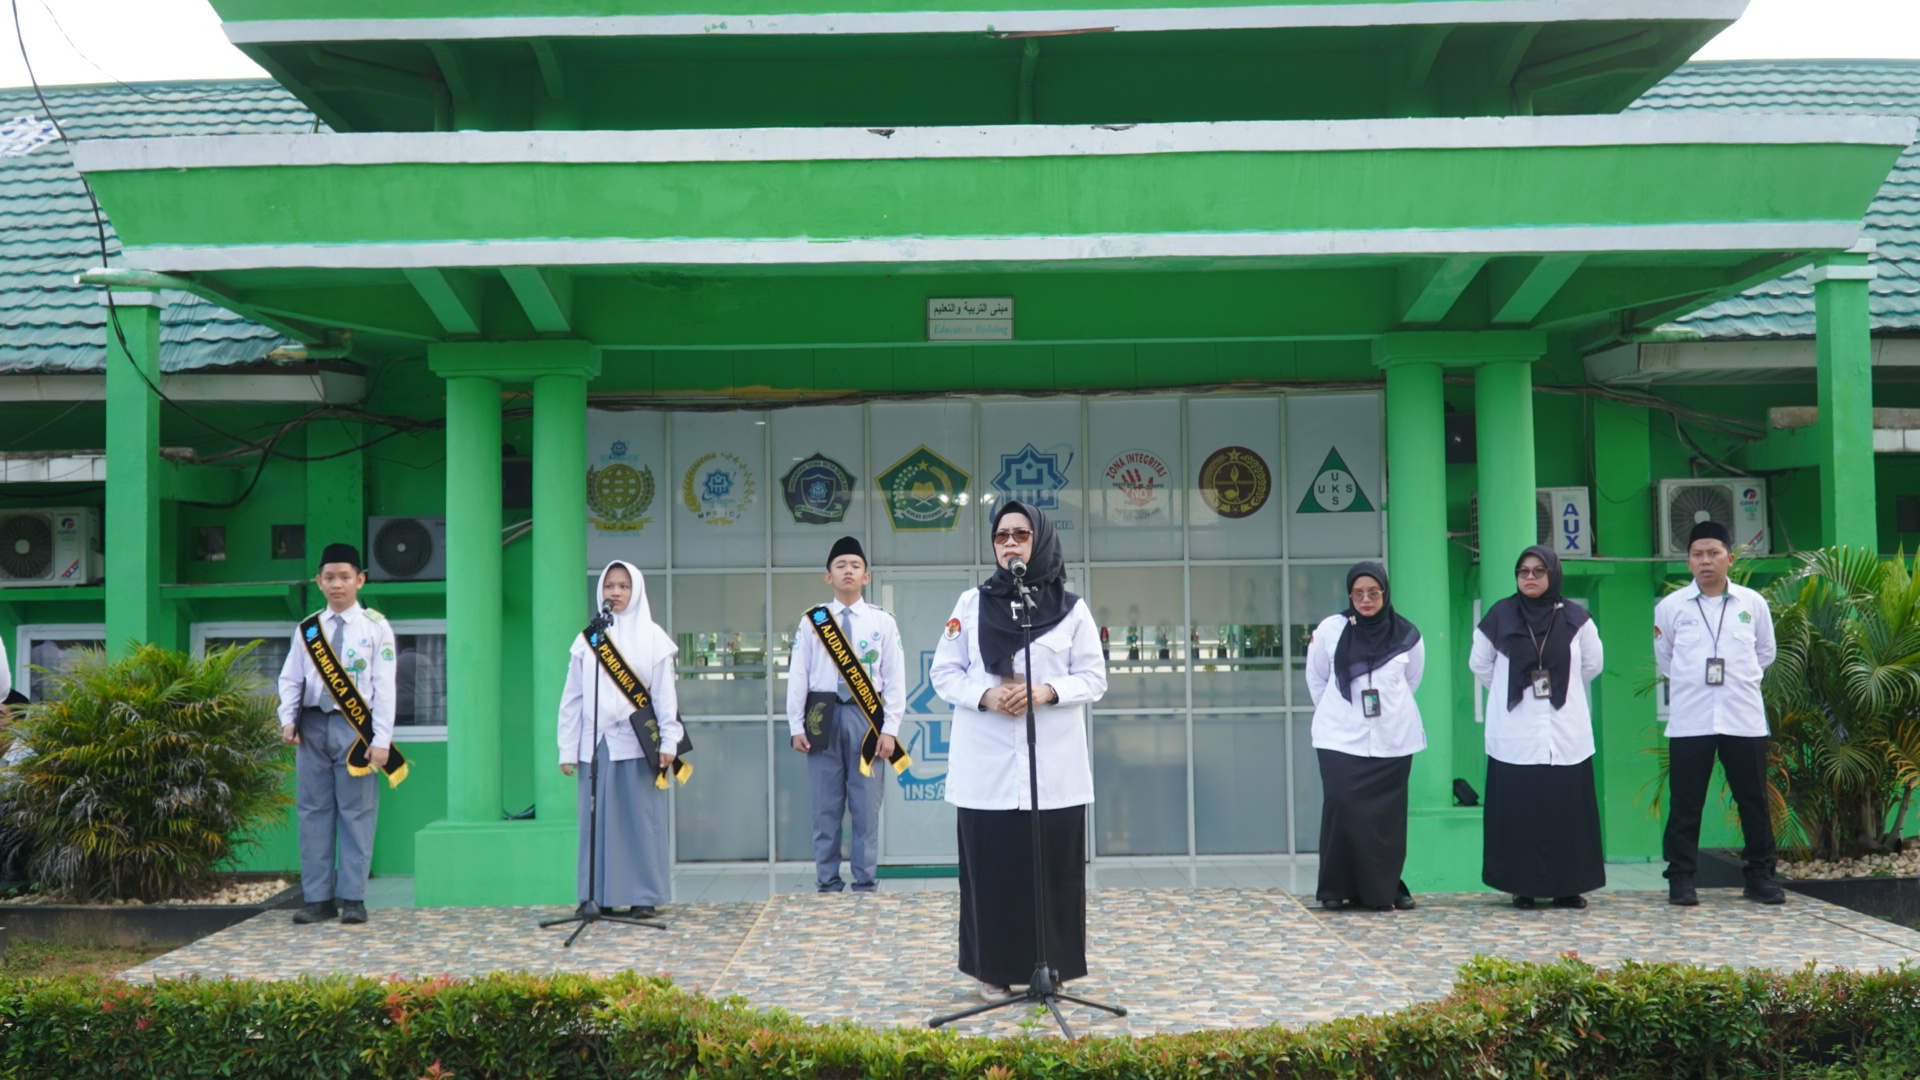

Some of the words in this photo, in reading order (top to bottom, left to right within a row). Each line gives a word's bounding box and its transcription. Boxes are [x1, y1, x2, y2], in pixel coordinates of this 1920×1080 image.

[933, 323, 973, 335] Education
[975, 323, 1010, 337] Building
[1105, 457, 1126, 479] ZONA
[1125, 452, 1168, 478] INTEGRITAS
[1131, 488, 1148, 500] NO
[1563, 503, 1580, 551] AUX
[310, 640, 350, 698] PEMBACA
[344, 696, 367, 726] DOA
[598, 643, 637, 693] PEMBAWA
[820, 623, 853, 667] AJUDAN
[845, 664, 879, 715] PEMBINA
